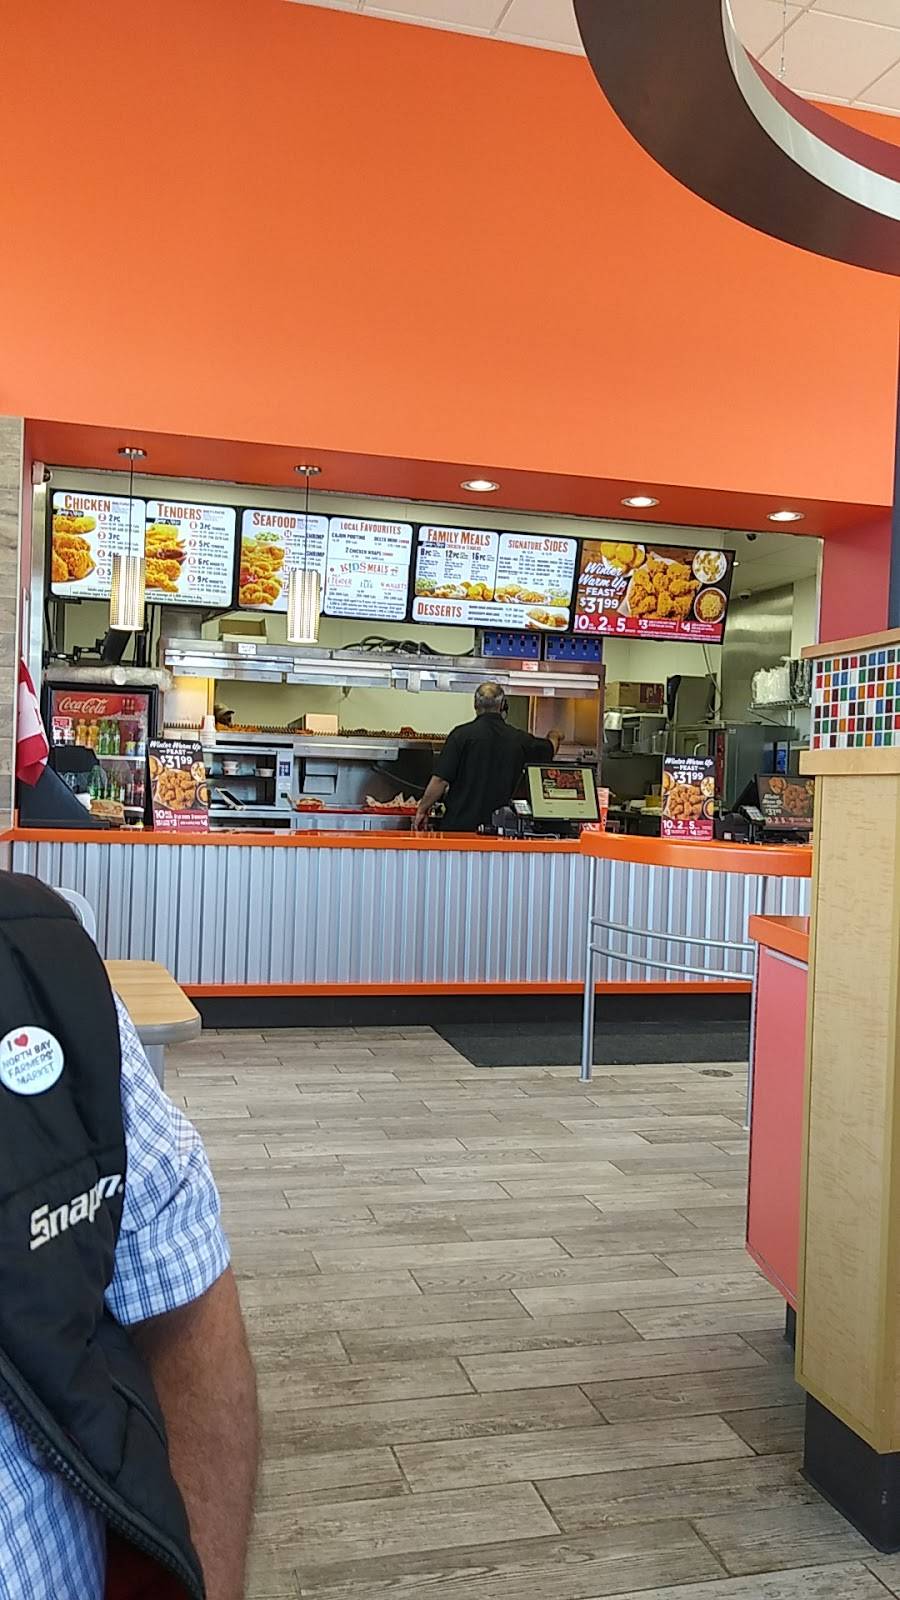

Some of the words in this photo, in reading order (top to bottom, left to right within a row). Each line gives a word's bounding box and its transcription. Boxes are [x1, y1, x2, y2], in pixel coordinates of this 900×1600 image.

[64, 494, 111, 513] CHICKEN
[157, 503, 202, 521] TENDERS
[252, 512, 297, 529] SEAFOOD
[340, 522, 359, 531] LOCAL
[360, 522, 402, 535] FAVOURITES
[428, 528, 459, 543] FAMILY
[460, 531, 491, 546] MEALS
[508, 539, 542, 551] SIGNATURE
[543, 538, 569, 553] SIDES
[584, 561, 623, 576] Winter
[577, 573, 611, 587] Warm
[611, 576, 627, 591] Up
[586, 587, 616, 597] FEAST
[417, 602, 463, 618] DESSERTS
[573, 614, 590, 630] 10
[597, 616, 609, 631] 2
[616, 617, 626, 633] 5
[2, 1048, 33, 1069] NORTH
[34, 1039, 51, 1054] BAY
[16, 1060, 54, 1085] MARKET
